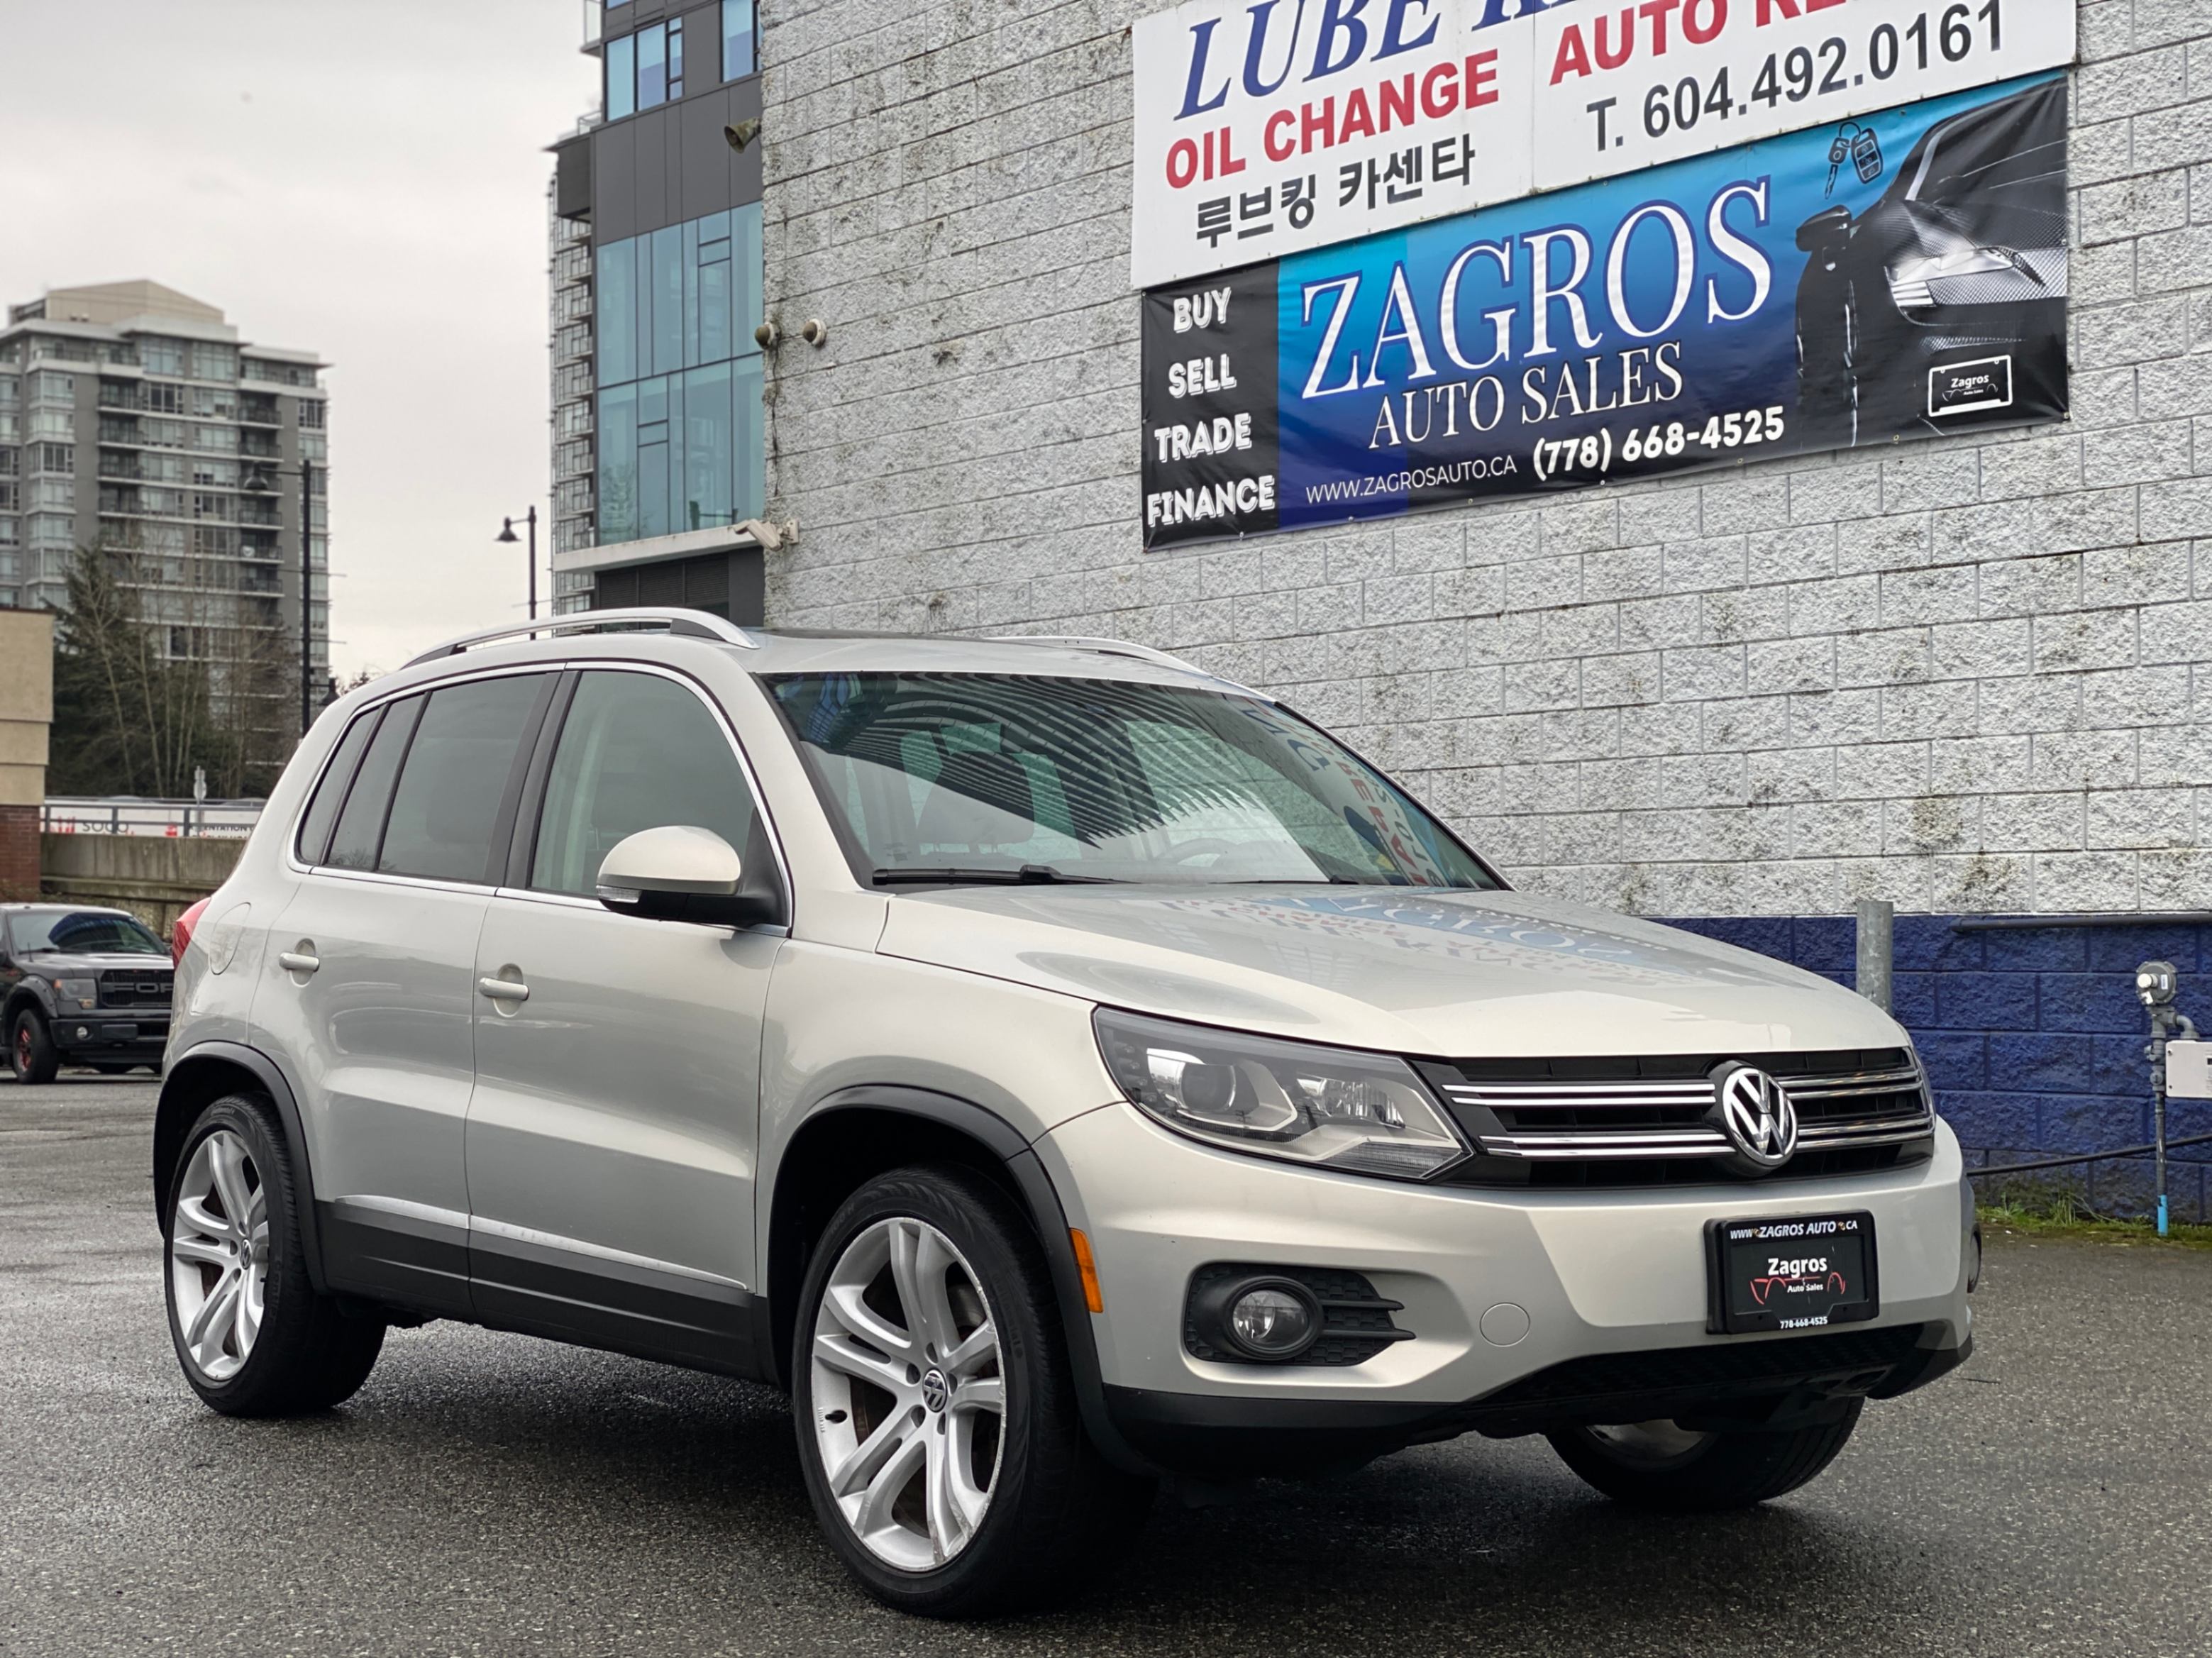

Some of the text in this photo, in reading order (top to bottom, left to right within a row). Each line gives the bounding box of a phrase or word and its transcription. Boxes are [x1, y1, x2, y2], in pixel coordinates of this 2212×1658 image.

[1173, 0, 1442, 120] LUBE
[1549, 0, 1729, 86] AUTO
[1586, 0, 2001, 151] T. 604.492.0161
[1166, 49, 1498, 189] OIL CHANGE
[1196, 134, 1476, 248] 루브킹 카센타
[1173, 287, 1232, 333] BUY
[1300, 175, 1773, 399] ZAGROS
[1168, 354, 1237, 398] SELL
[1368, 341, 1683, 449] AUTO SALES
[1951, 375, 1989, 389] Zagros
[1154, 412, 1252, 463] TRADE
[1532, 406, 1785, 480] (778) 668-4525
[1147, 475, 1276, 526] FINANCE
[1306, 455, 1517, 504] WWW.ZAGROSAUTO.CA
[1768, 1256, 1827, 1278] Zagros
[1787, 1282, 1823, 1293] Auto Sales
[1780, 1317, 1828, 1330] 778-668-4525
